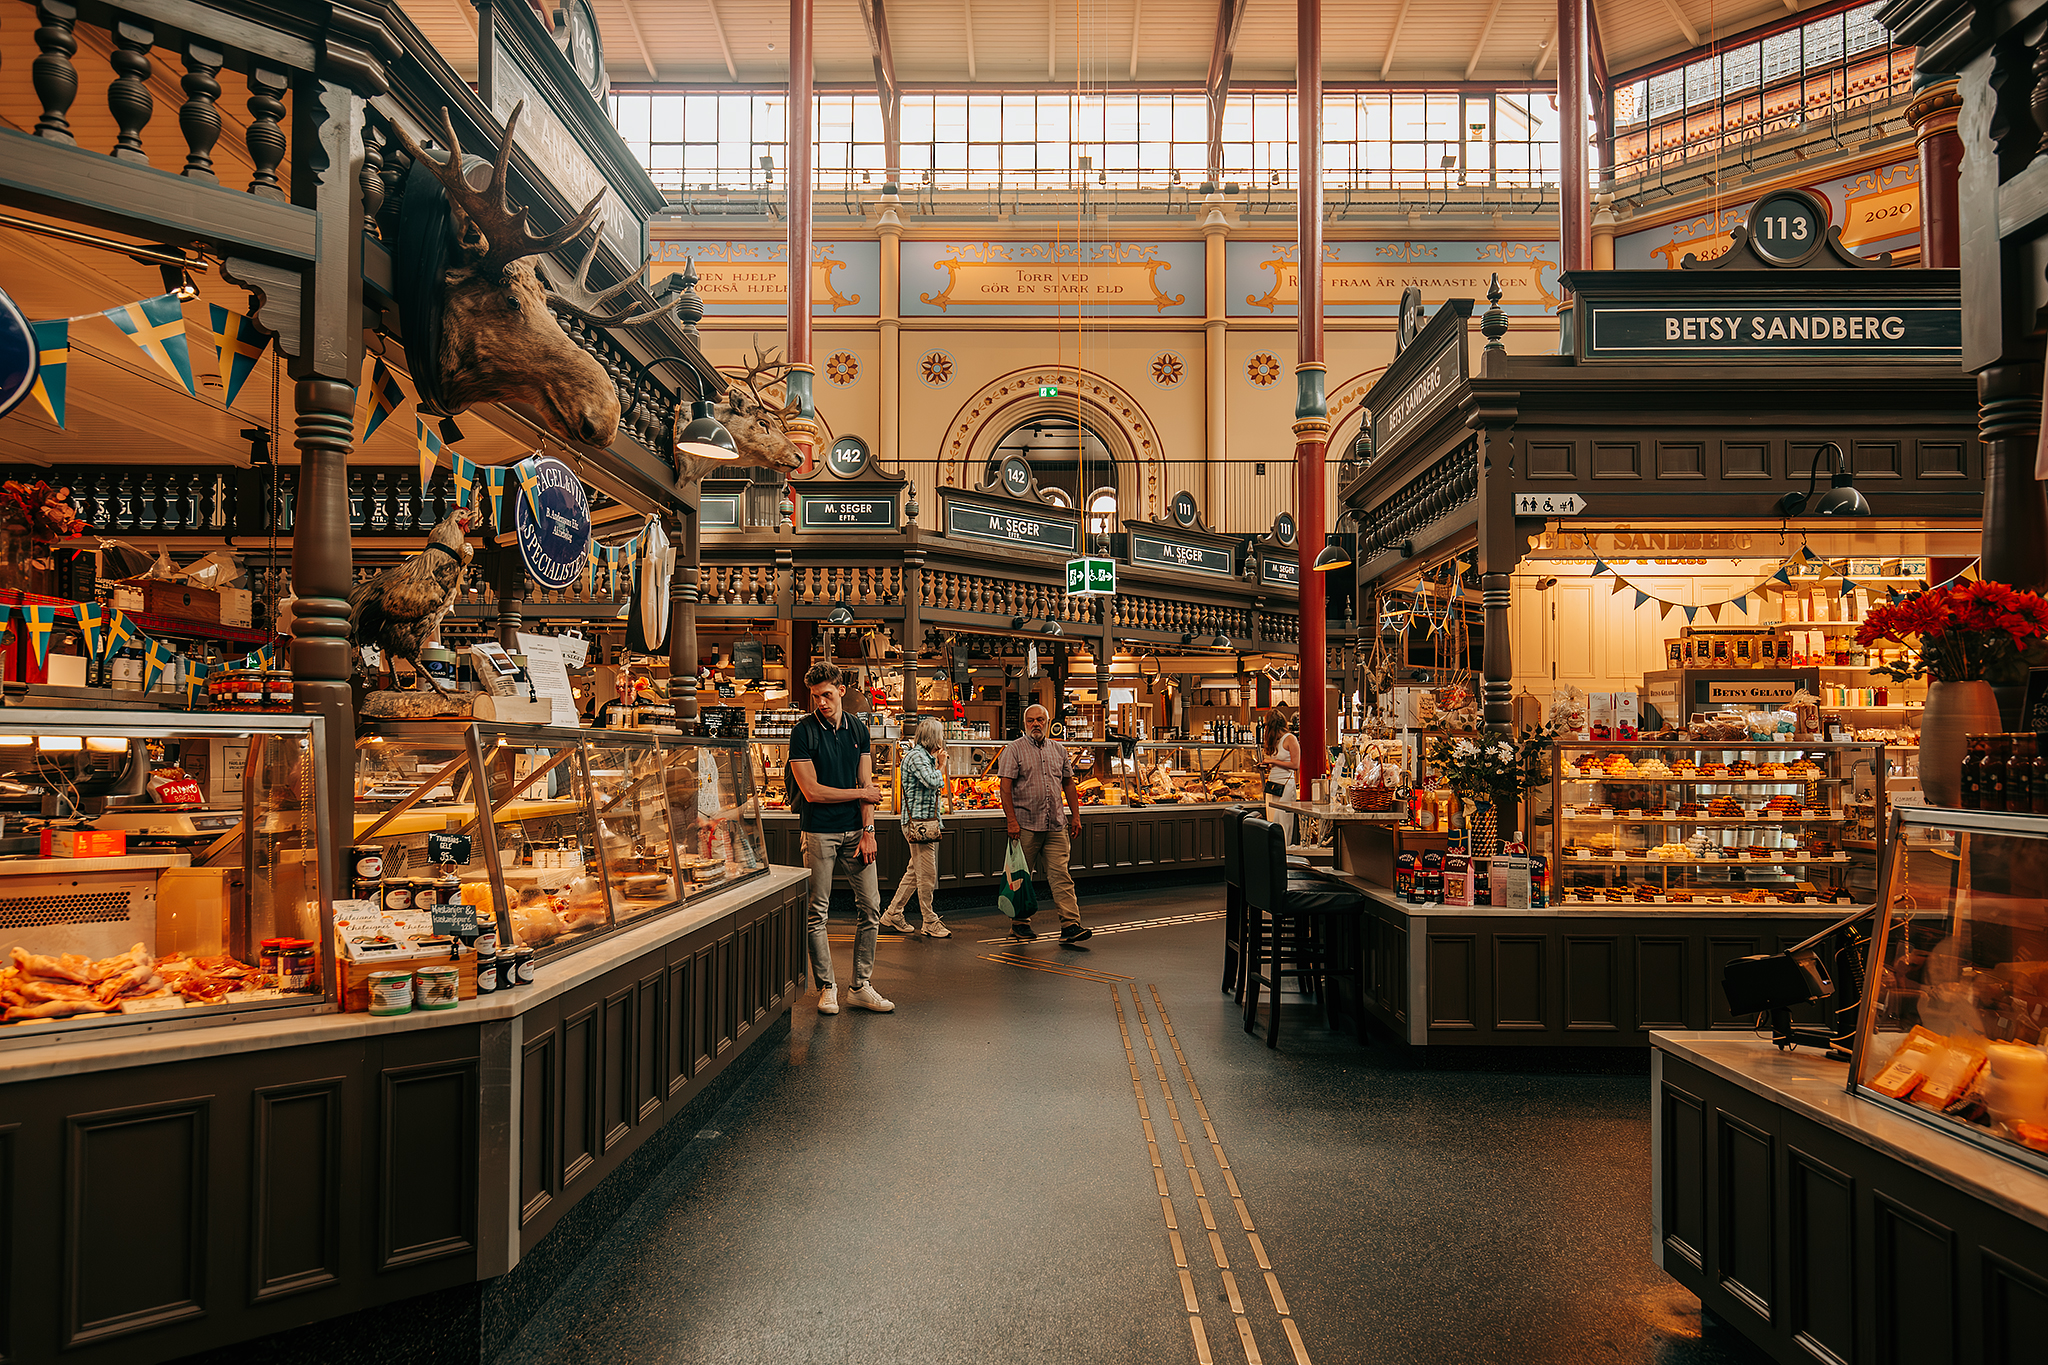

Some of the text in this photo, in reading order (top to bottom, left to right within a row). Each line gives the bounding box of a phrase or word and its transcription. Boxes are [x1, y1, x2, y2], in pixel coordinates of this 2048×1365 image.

[573, 16, 594, 69] 143
[1864, 202, 1913, 224] 2020
[1763, 216, 1808, 241] 113
[1696, 245, 1729, 261] 888
[733, 273, 777, 281] HJELP
[1061, 273, 1089, 282] VED
[1331, 278, 1372, 287] FRAM
[1375, 276, 1396, 287] ÄR
[1401, 276, 1477, 287] NÄRMASTE
[1481, 278, 1528, 287] VGEN
[981, 282, 1124, 293] GÖR EN STARK ELD
[1403, 306, 1415, 333] 113
[1665, 316, 1906, 341] BETSY SANDBERG
[1388, 366, 1441, 432] BETSY SANDBERG
[835, 449, 861, 463] 142
[1007, 468, 1025, 484] 142
[824, 504, 872, 514] M. SEGER
[1178, 502, 1191, 516] 111
[989, 516, 1040, 537] M. SEGER
[1280, 522, 1291, 535] 111
[1613, 524, 1752, 550] SANDBERG
[1163, 545, 1203, 563] M. SEGER
[1279, 565, 1295, 574] SEGER
[1712, 687, 1793, 697] BETSY GELATO
